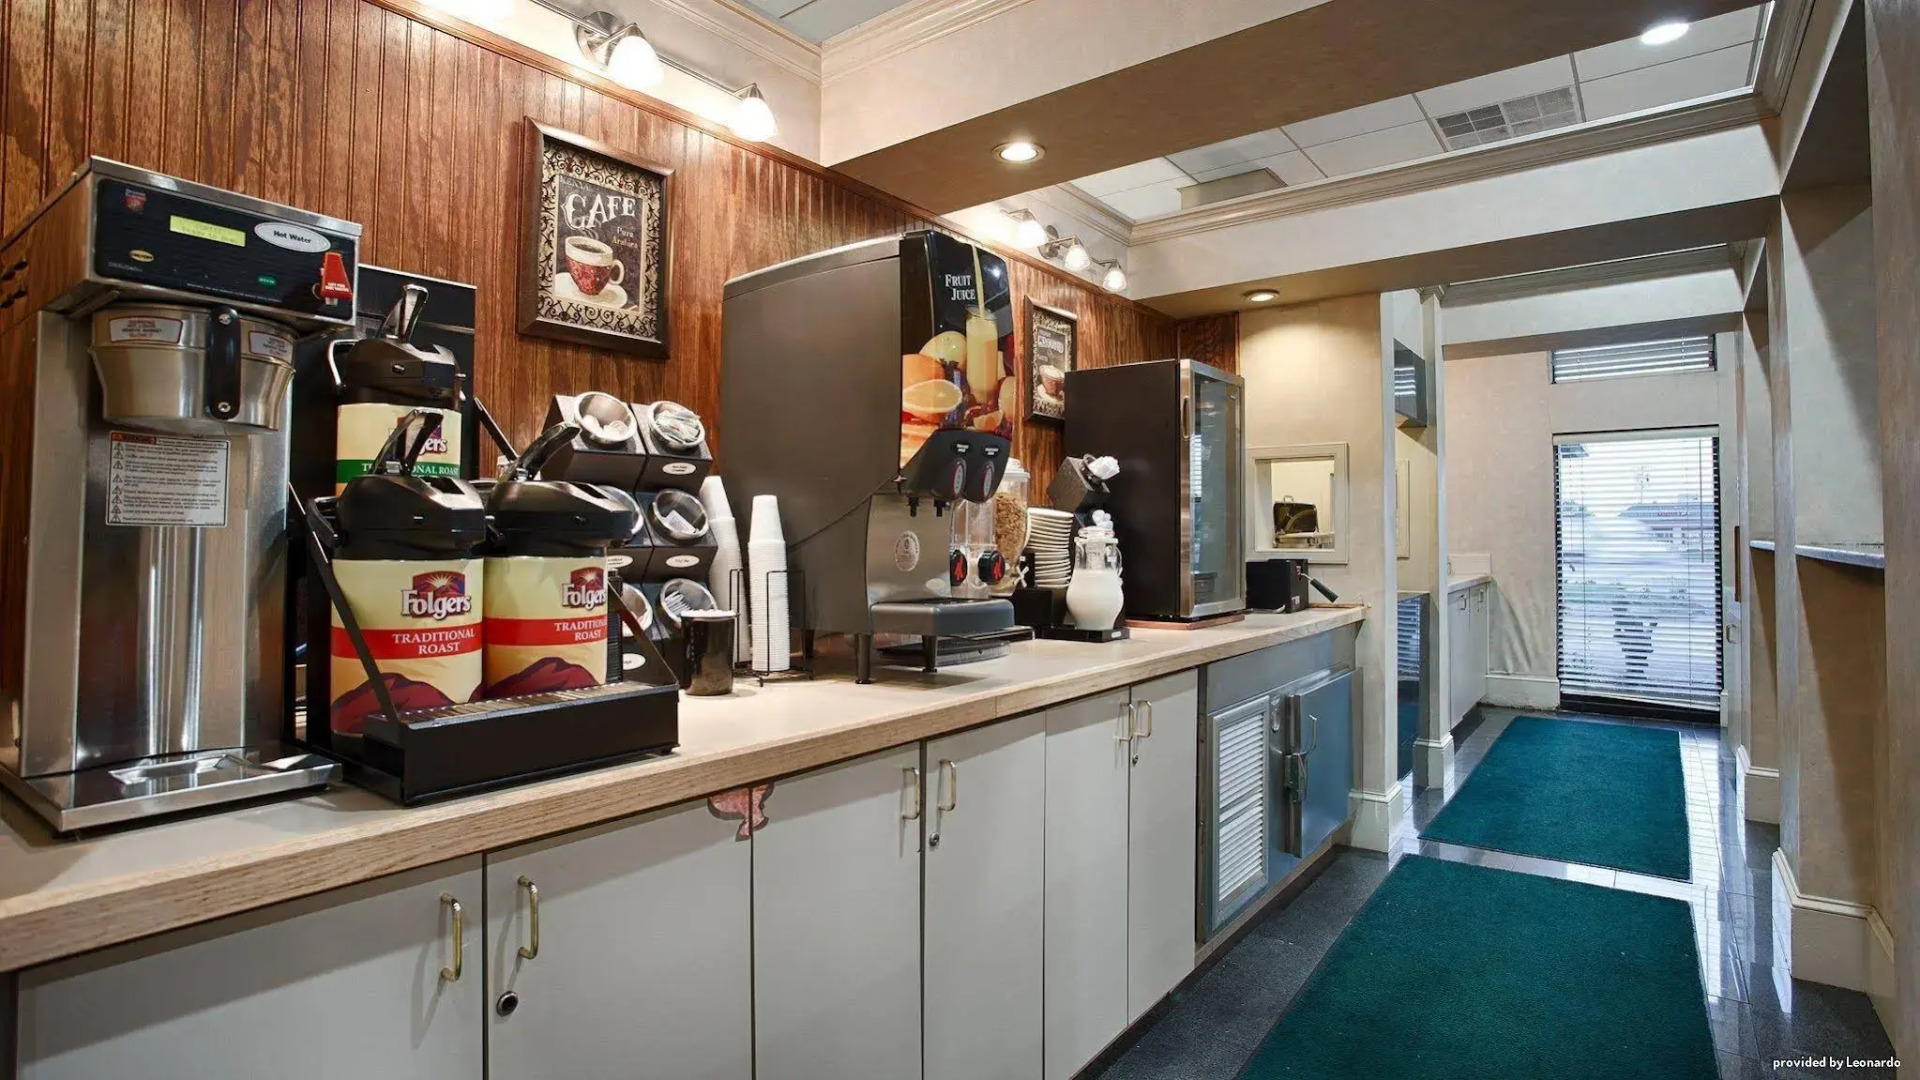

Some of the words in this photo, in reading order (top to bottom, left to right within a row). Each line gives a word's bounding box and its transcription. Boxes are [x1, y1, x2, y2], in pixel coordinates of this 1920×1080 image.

[561, 192, 637, 230] CAFE
[273, 230, 288, 240] Hot
[289, 233, 312, 244] Water
[945, 273, 971, 287] FRUIT
[951, 288, 976, 301] JUICE
[401, 589, 472, 621] Folgers
[392, 628, 475, 644] TRADITIONAL
[574, 629, 602, 641] ROAST
[418, 642, 460, 655] ROAST
